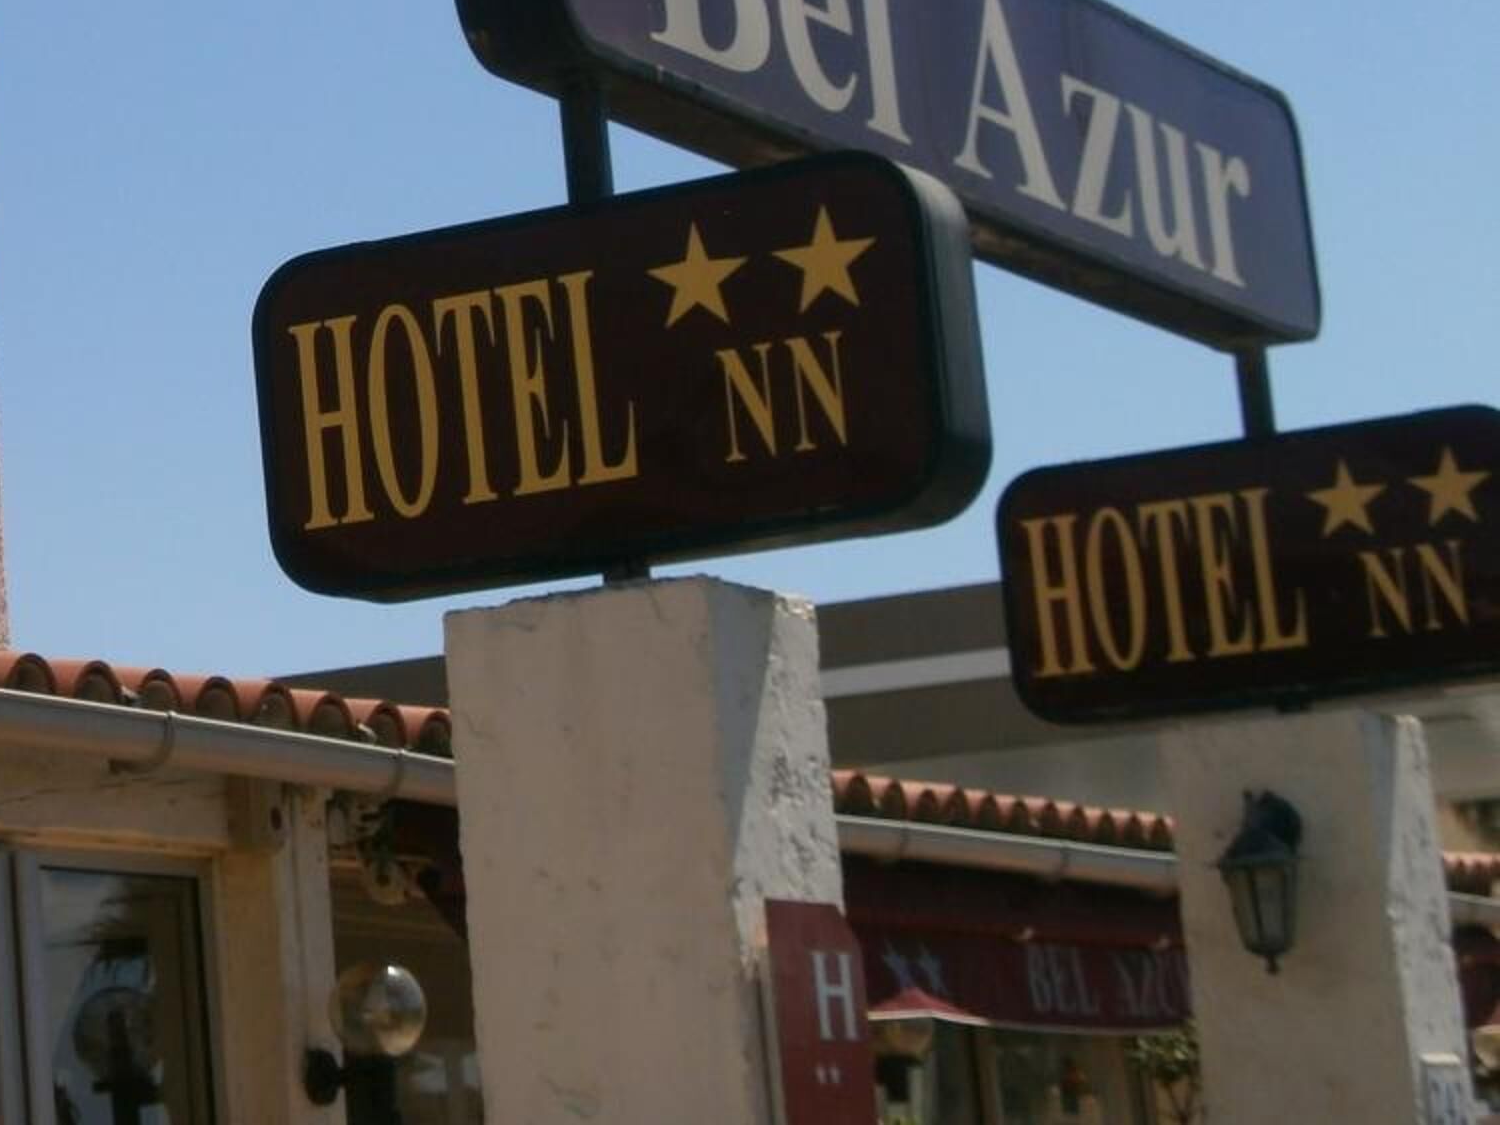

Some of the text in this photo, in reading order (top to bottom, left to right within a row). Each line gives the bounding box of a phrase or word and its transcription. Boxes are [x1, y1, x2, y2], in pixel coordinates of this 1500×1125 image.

[288, 270, 849, 531] HOTEL NN
[1019, 487, 1472, 677] HOTEL NN
[811, 950, 859, 1042] H
[1026, 944, 1190, 1019] BEL AZU
